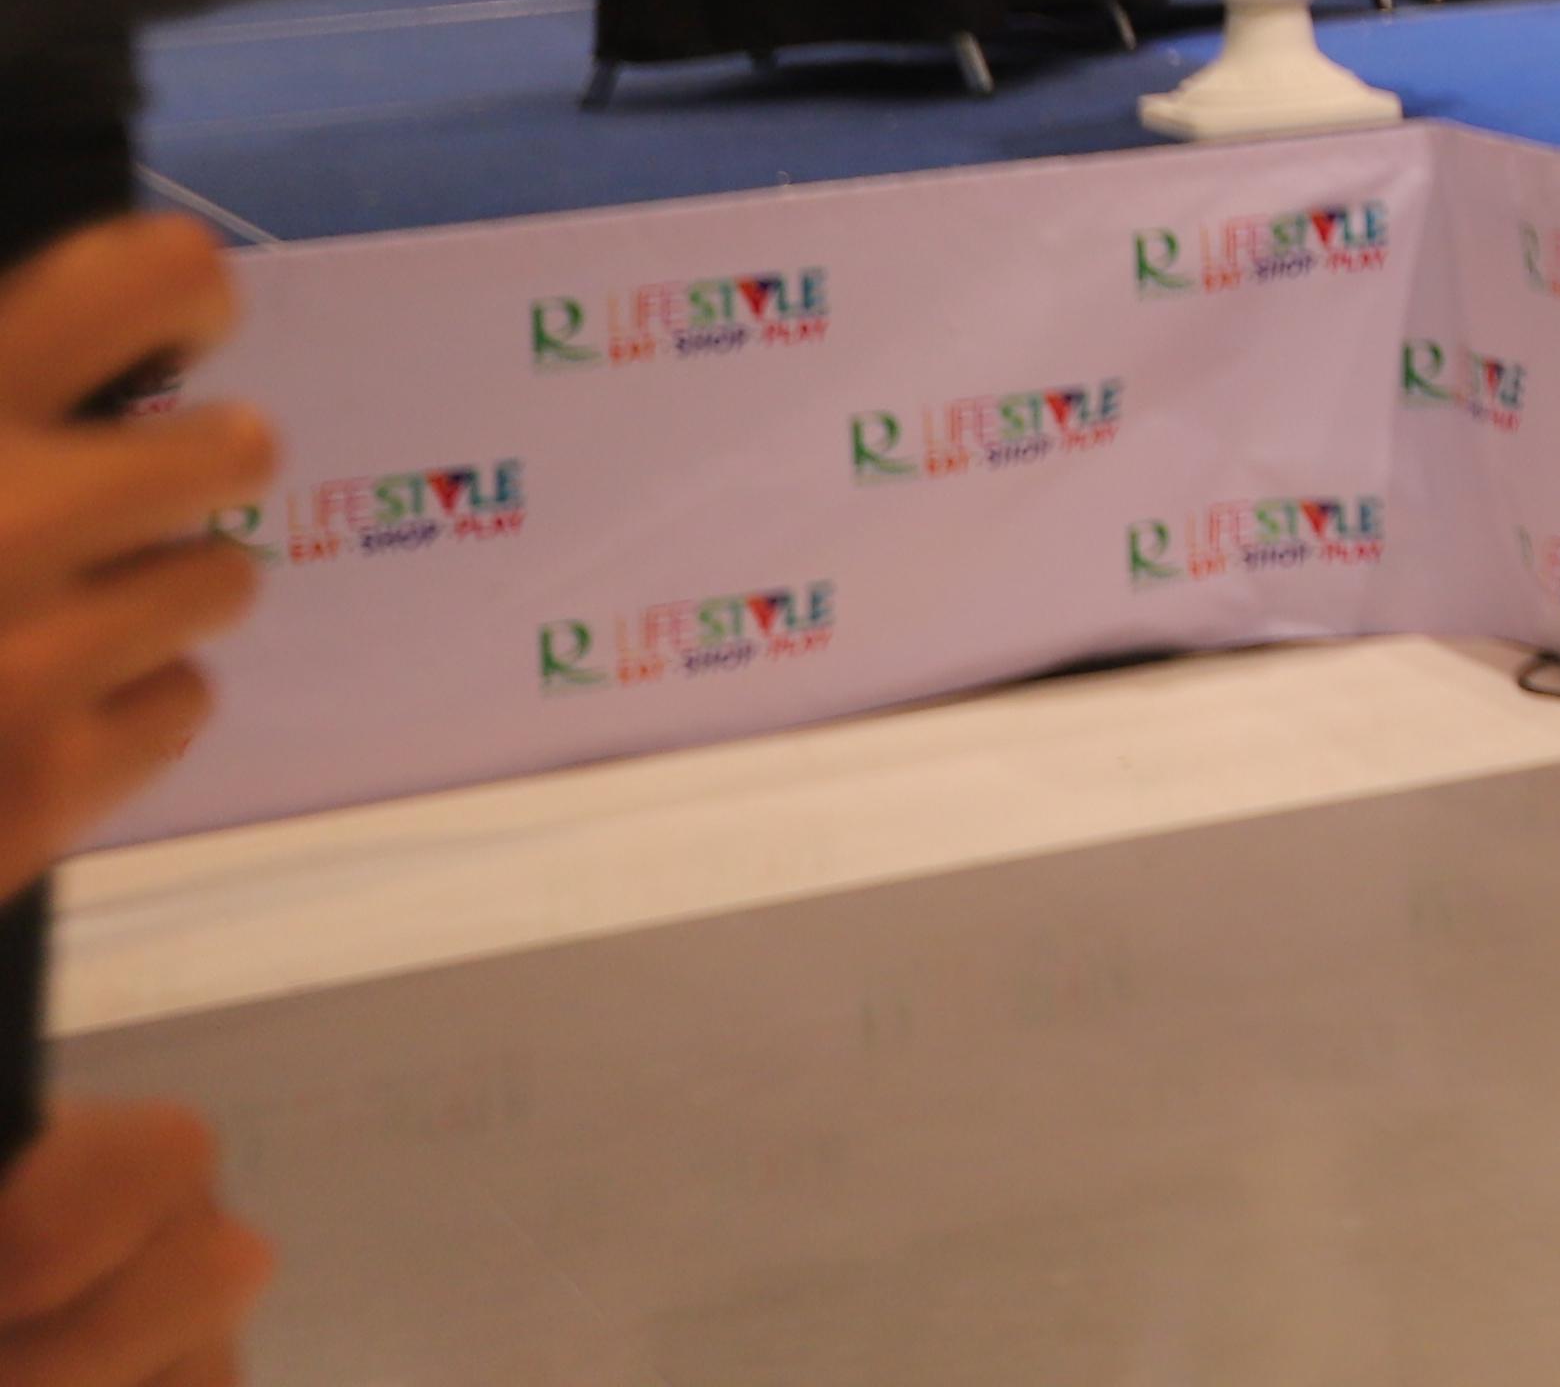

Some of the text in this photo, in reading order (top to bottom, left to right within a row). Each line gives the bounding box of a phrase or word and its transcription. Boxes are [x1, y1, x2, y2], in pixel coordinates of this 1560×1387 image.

[1200, 198, 1388, 270] LIFESTYLE
[607, 265, 828, 340] LIFESTYLE
[921, 376, 1124, 449] LIFESTYLE
[285, 457, 524, 532] LIFESTYLE
[1186, 495, 1384, 561] LIFESTYLE
[614, 578, 834, 657] LIFESTYLE
